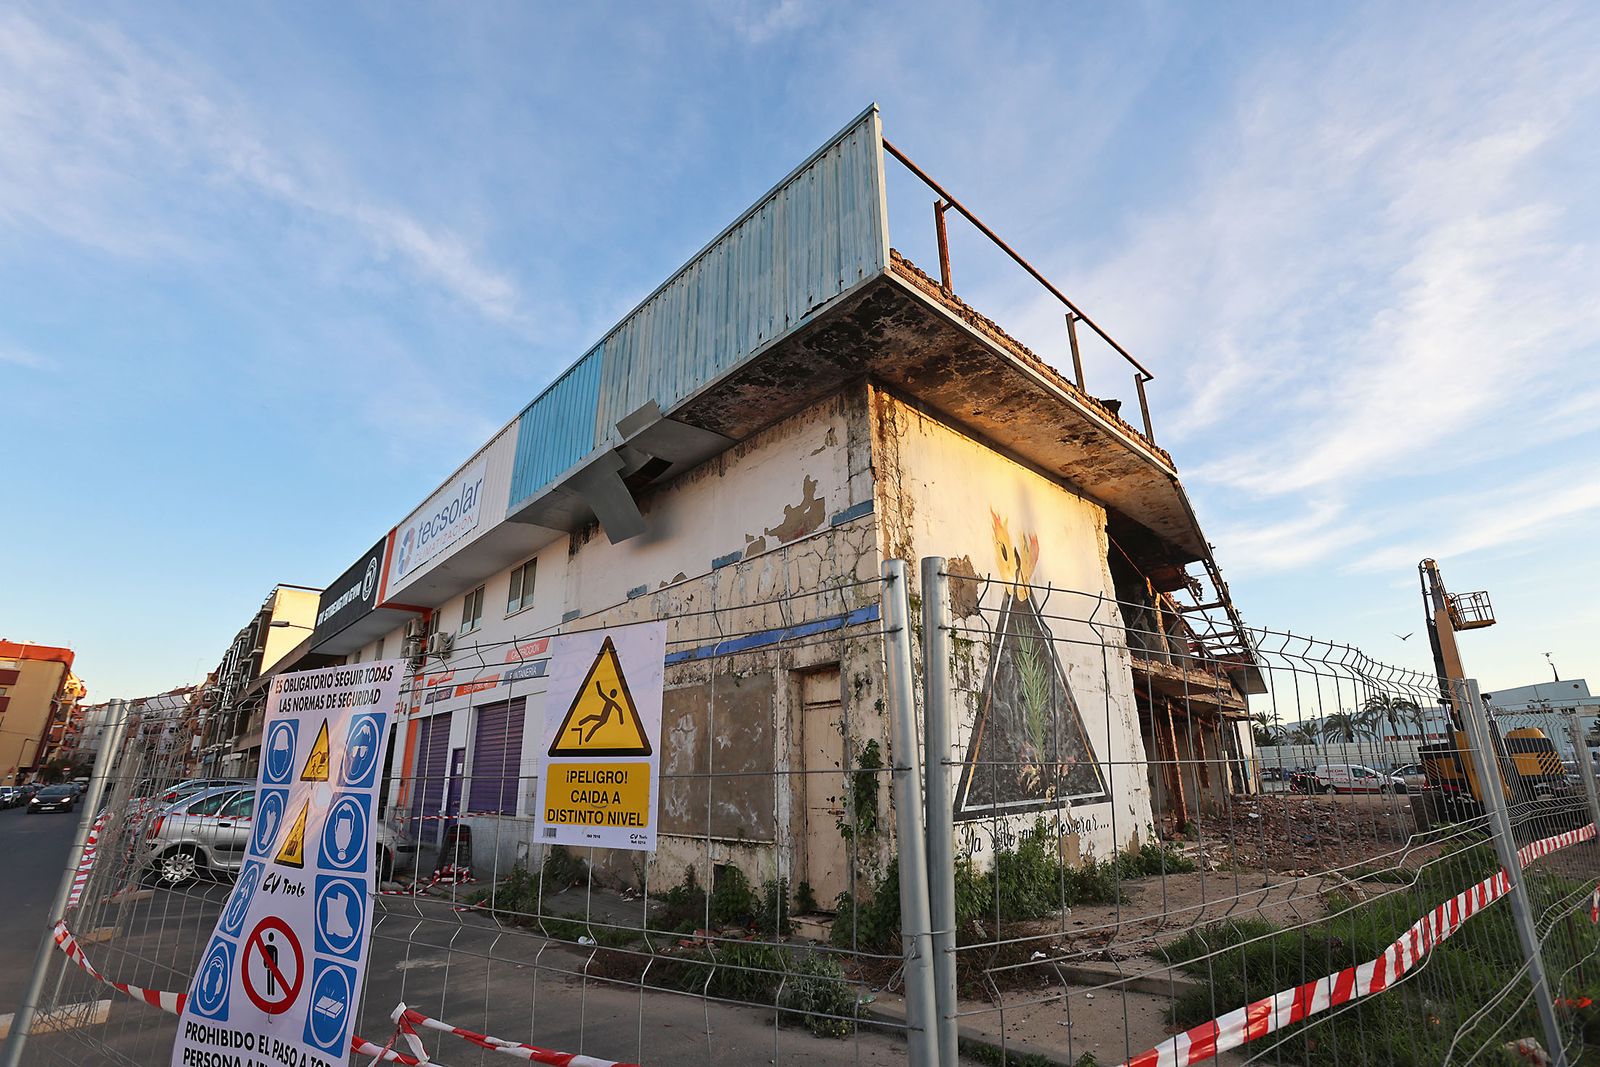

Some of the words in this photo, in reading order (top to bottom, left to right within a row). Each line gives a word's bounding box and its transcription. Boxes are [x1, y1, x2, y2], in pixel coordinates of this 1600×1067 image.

[416, 478, 483, 549] tecsolar
[275, 680, 283, 694] ES
[283, 673, 333, 693] OBLIGATORIO
[334, 669, 363, 688] SEGUIR
[364, 665, 394, 686] TODAS
[279, 698, 292, 713] LAS
[292, 693, 324, 712] NORMAS
[326, 692, 337, 709] DE
[338, 688, 381, 708] SEGURIDAD
[566, 770, 628, 784] ¡PELIGRO!
[570, 789, 609, 804] CAIDA
[612, 791, 621, 804] A
[547, 809, 604, 825] DISTINTO
[607, 811, 644, 826] NIVEL
[262, 871, 282, 895] CV
[282, 878, 306, 898] Tools
[184, 1020, 255, 1051] PROHIBIDO
[258, 1034, 270, 1056] EL
[272, 1039, 298, 1067] PASO
[299, 1053, 307, 1067] A
